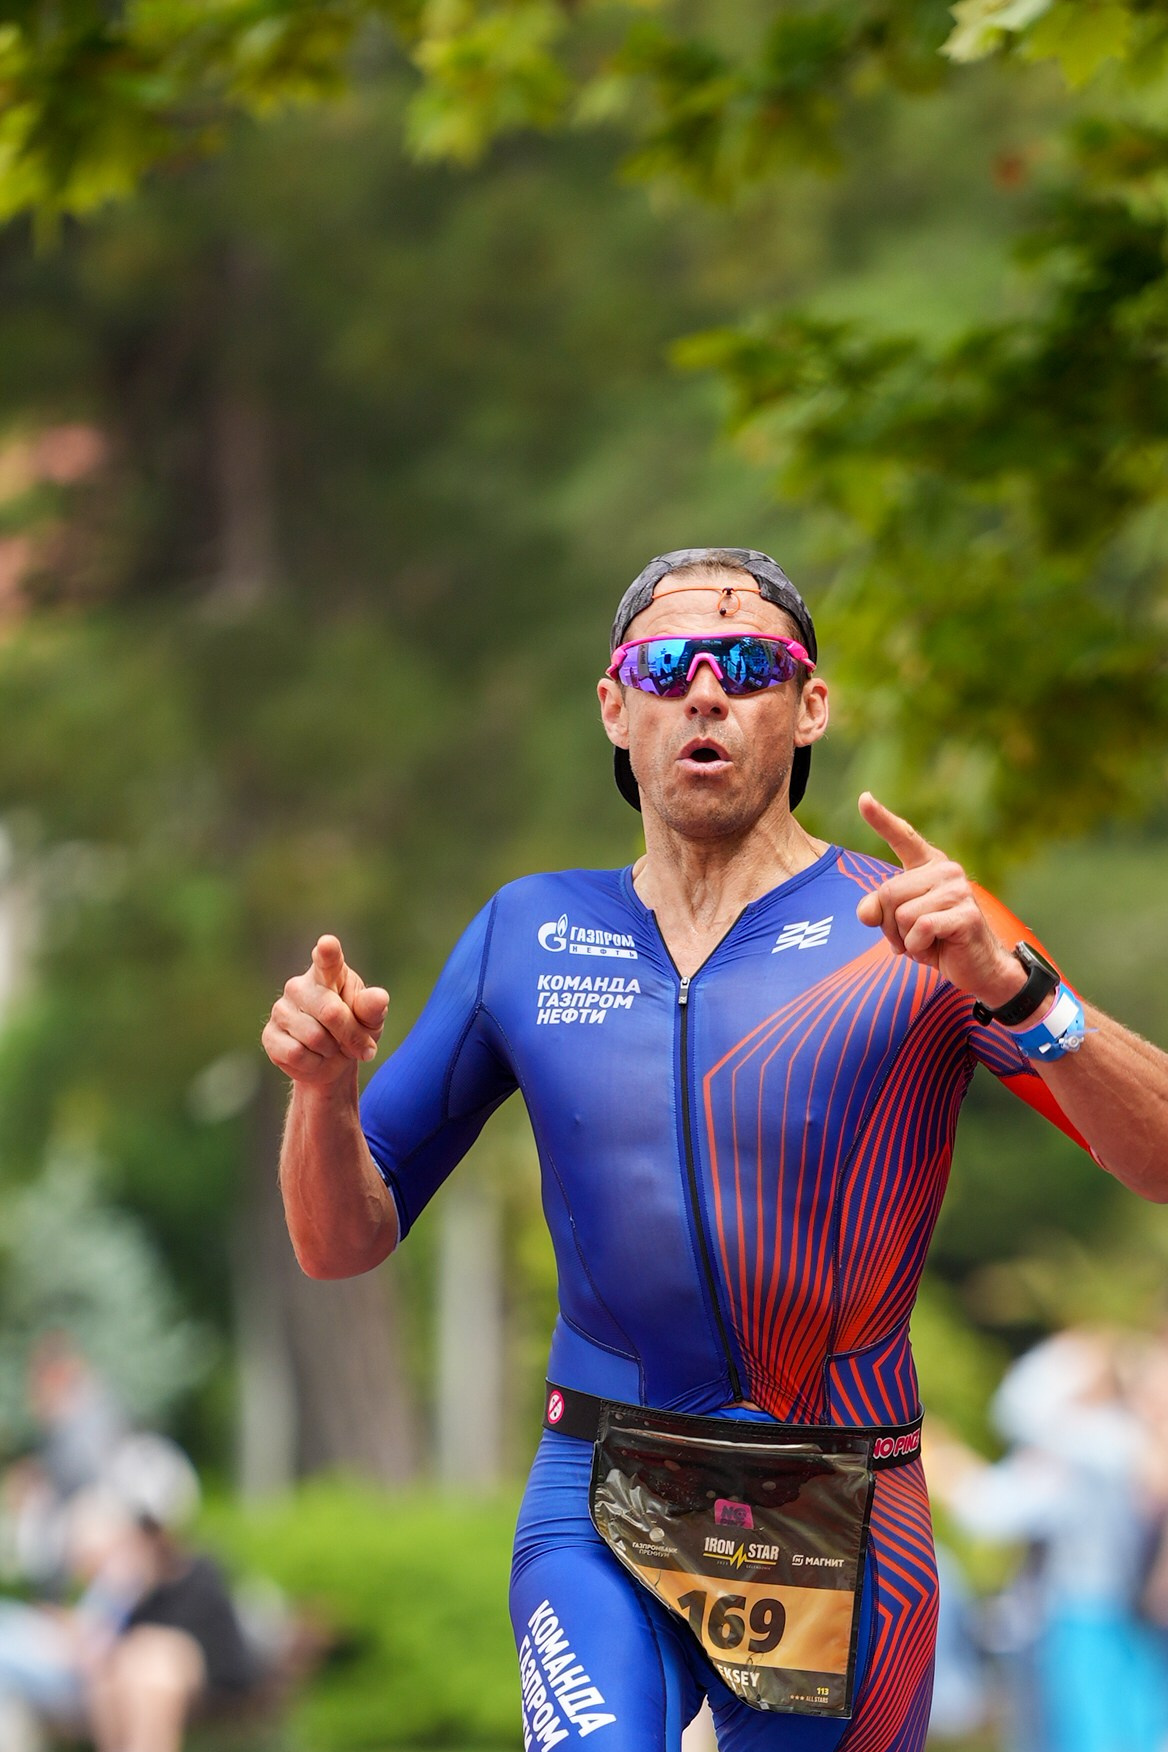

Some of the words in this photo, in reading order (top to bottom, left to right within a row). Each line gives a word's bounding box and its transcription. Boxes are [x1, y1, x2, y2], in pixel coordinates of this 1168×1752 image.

[570, 926, 636, 948] ГАЗПРОМ
[572, 946, 635, 958] НЕФТЬ
[537, 974, 641, 994] КОМАНДА
[537, 991, 634, 1009] ГАЗПРОМ
[536, 1008, 607, 1025] НЕФТИ
[703, 1536, 735, 1556] IRON
[748, 1542, 780, 1561] STAR
[805, 1556, 845, 1568] МАГНИТ
[677, 1589, 786, 1654] 169
[528, 1599, 617, 1738] КОМАНДА
[816, 1687, 829, 1696] 113
